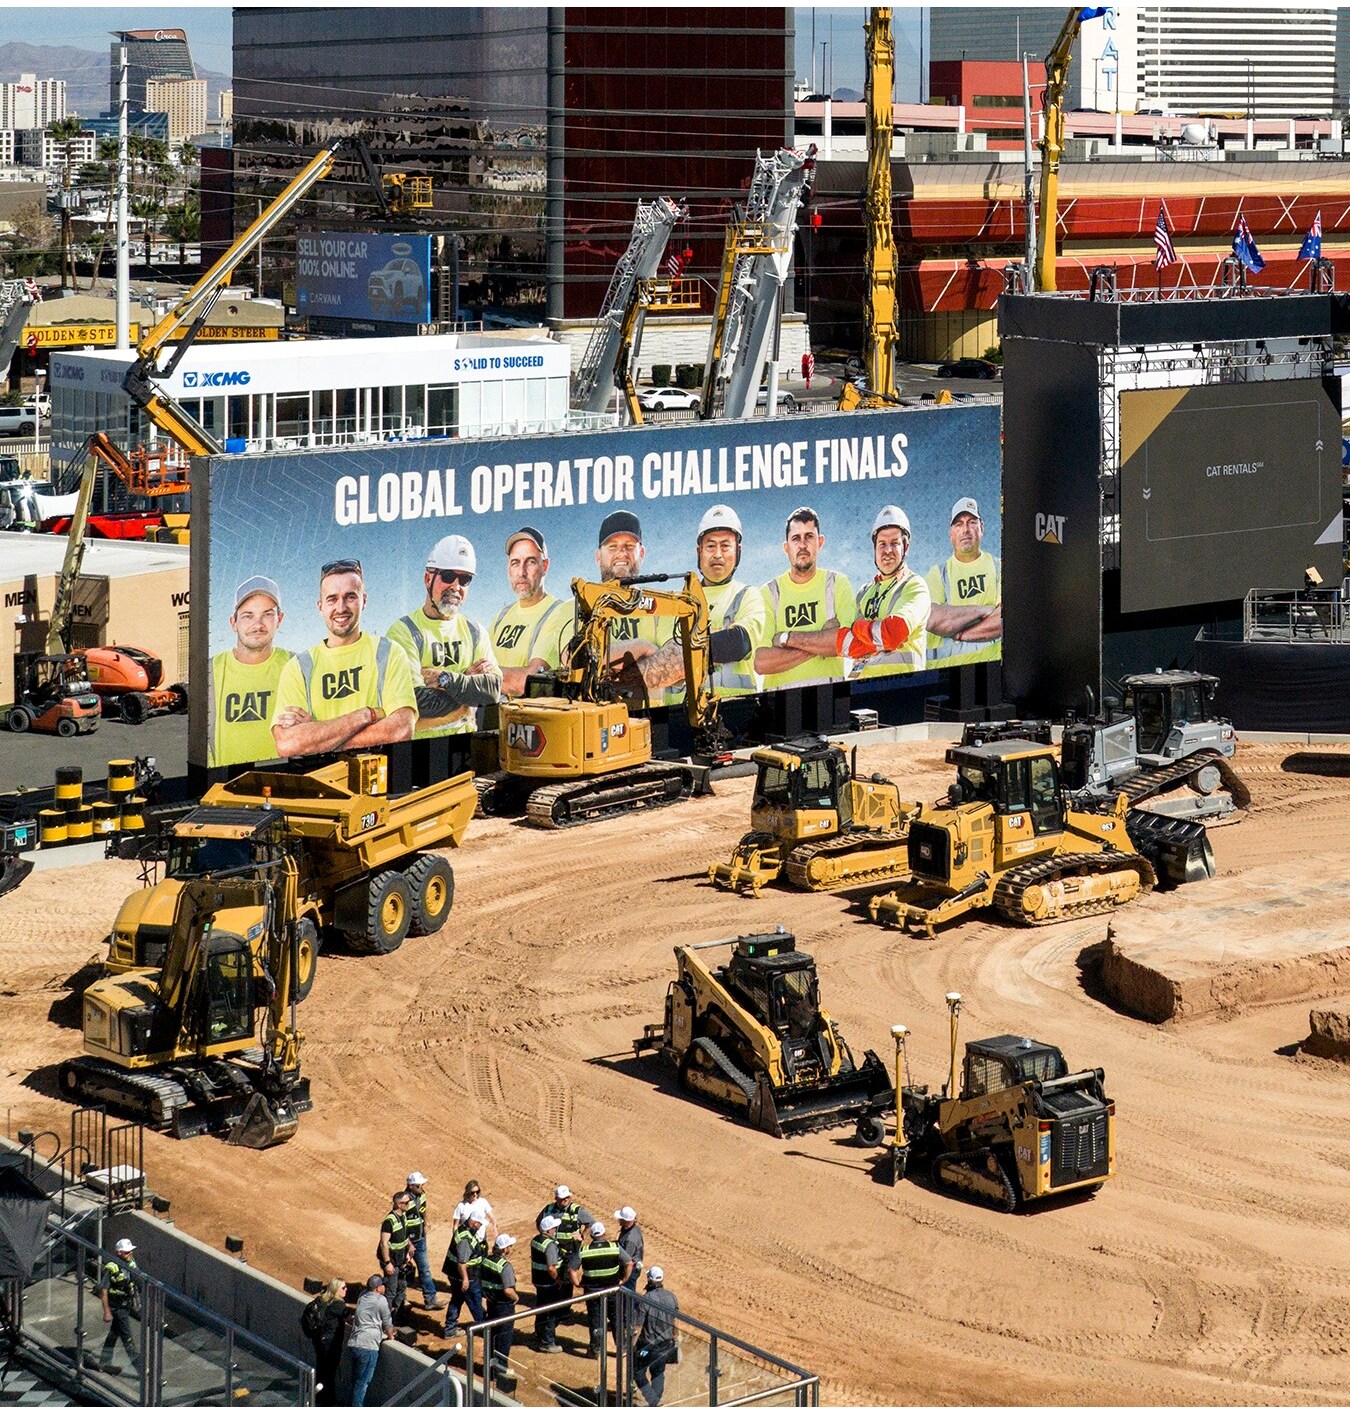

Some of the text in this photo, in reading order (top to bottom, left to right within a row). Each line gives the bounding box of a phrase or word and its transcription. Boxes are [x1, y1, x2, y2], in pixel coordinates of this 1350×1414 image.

[154, 30, 178, 41] Circa
[299, 239, 368, 259] SELL YOUR CAR
[298, 259, 320, 276] 100%
[309, 293, 341, 304] CARVANA
[196, 327, 266, 338] OLDEN STEER
[490, 357, 501, 369] TO
[503, 355, 544, 368] SUCCEED
[199, 371, 251, 388] XCMG
[335, 432, 909, 526] GLOBAL OPERATOR CHALLENGE FINALS
[1206, 466, 1221, 477] CAT
[1035, 512, 1066, 545] CAT
[957, 574, 988, 599] CAT
[5, 590, 37, 607] MEN
[640, 597, 654, 610] CAT
[785, 600, 820, 630] CAT
[497, 624, 528, 649] CAT
[431, 640, 462, 667] CAT
[322, 667, 364, 700] CAT
[225, 690, 272, 723] CAT
[508, 723, 535, 750] CAT
[611, 723, 624, 736] CAT
[1221, 729, 1232, 739] CAT
[361, 812, 376, 830] 730
[819, 820, 829, 829] CAT
[1008, 816, 1022, 827] CAT
[1101, 821, 1114, 831] 963
[1079, 1124, 1089, 1135] CAT
[1017, 1146, 1031, 1162] CAT
